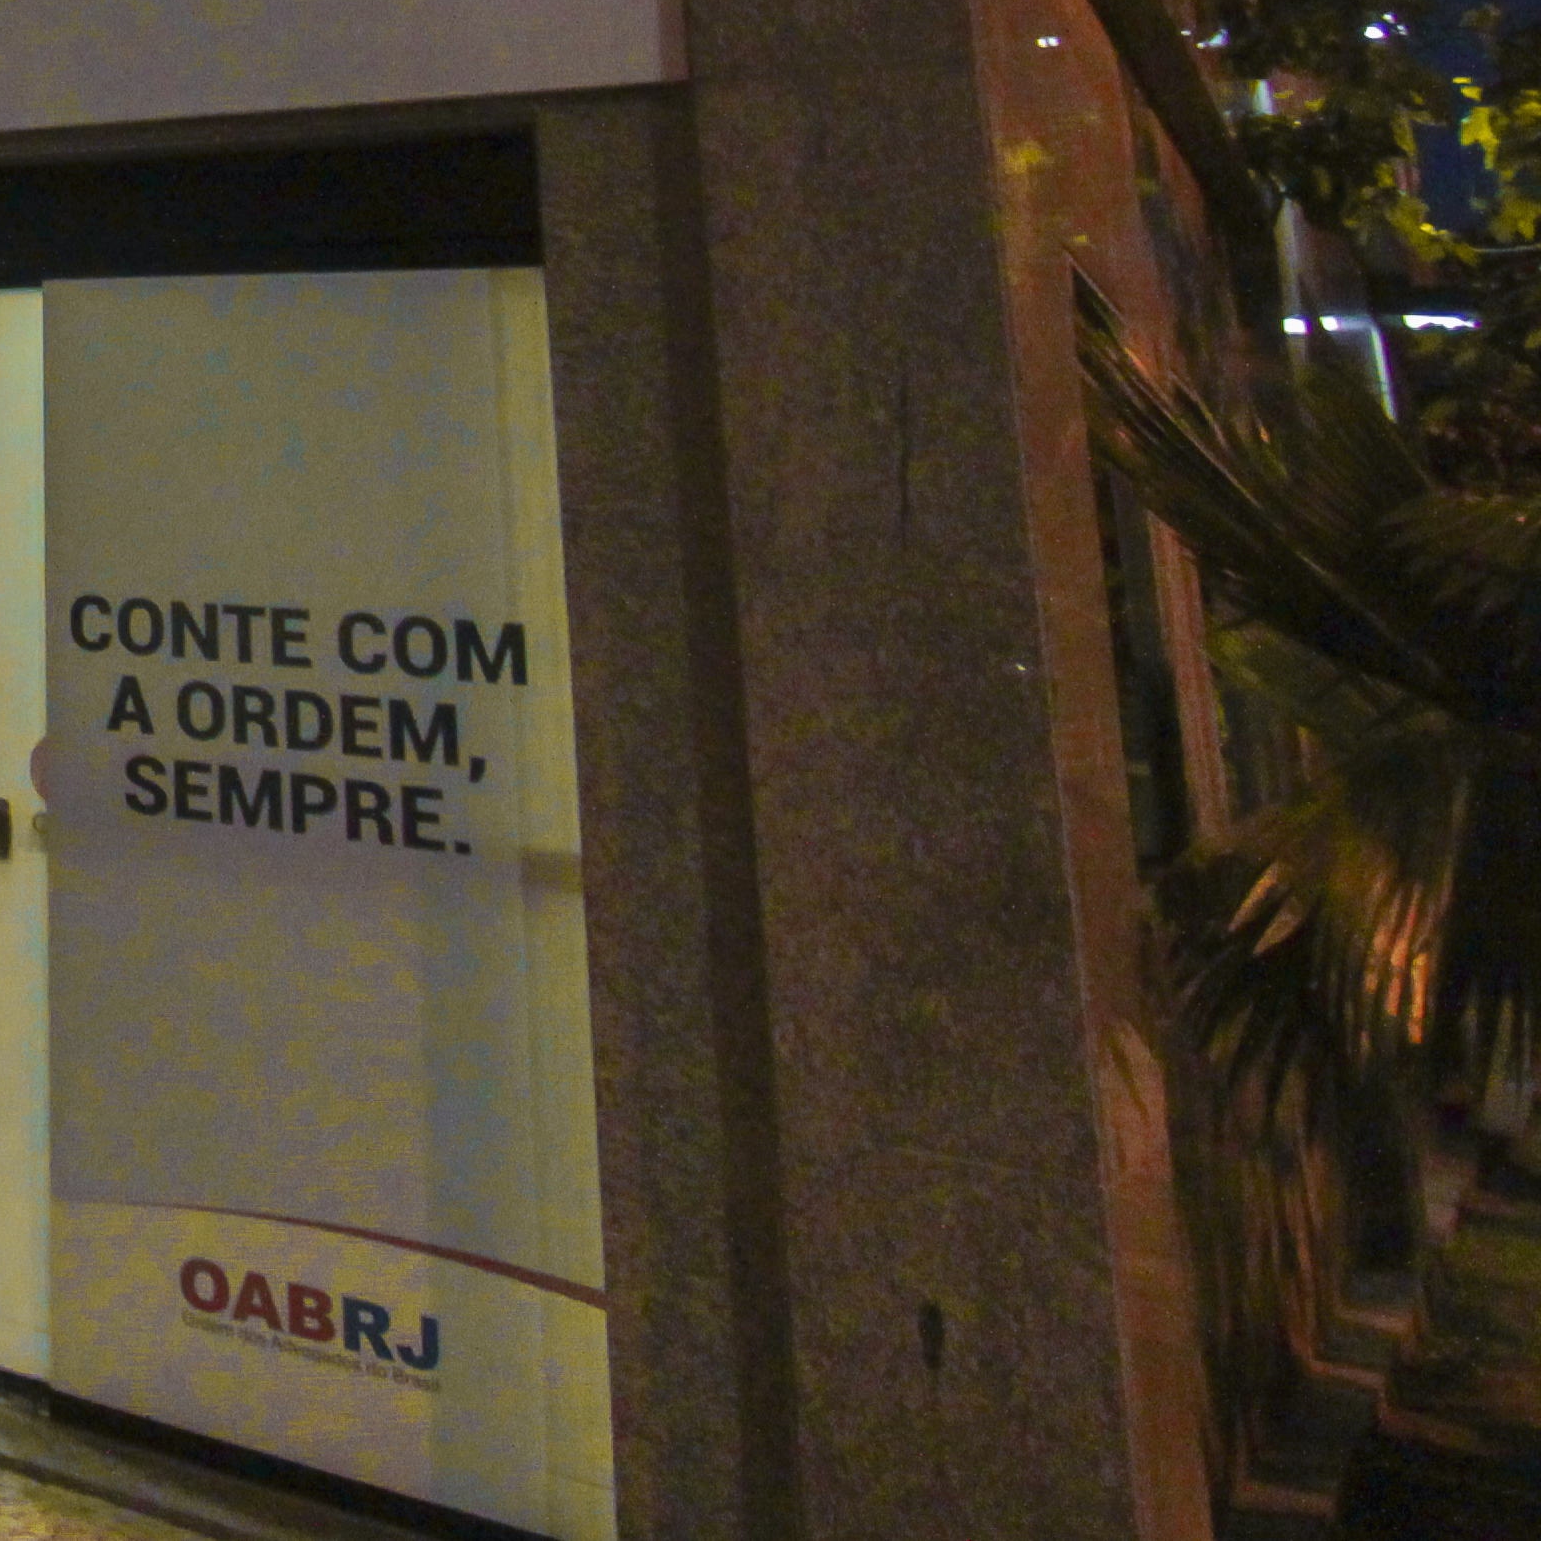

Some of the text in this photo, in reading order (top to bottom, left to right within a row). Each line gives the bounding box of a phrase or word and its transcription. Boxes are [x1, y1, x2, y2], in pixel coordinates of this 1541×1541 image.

[70, 594, 528, 686] CONTE COM
[107, 675, 486, 783] A ORDEM,
[124, 754, 471, 855] SEMPRE.
[179, 1258, 440, 1370] OABRJ
